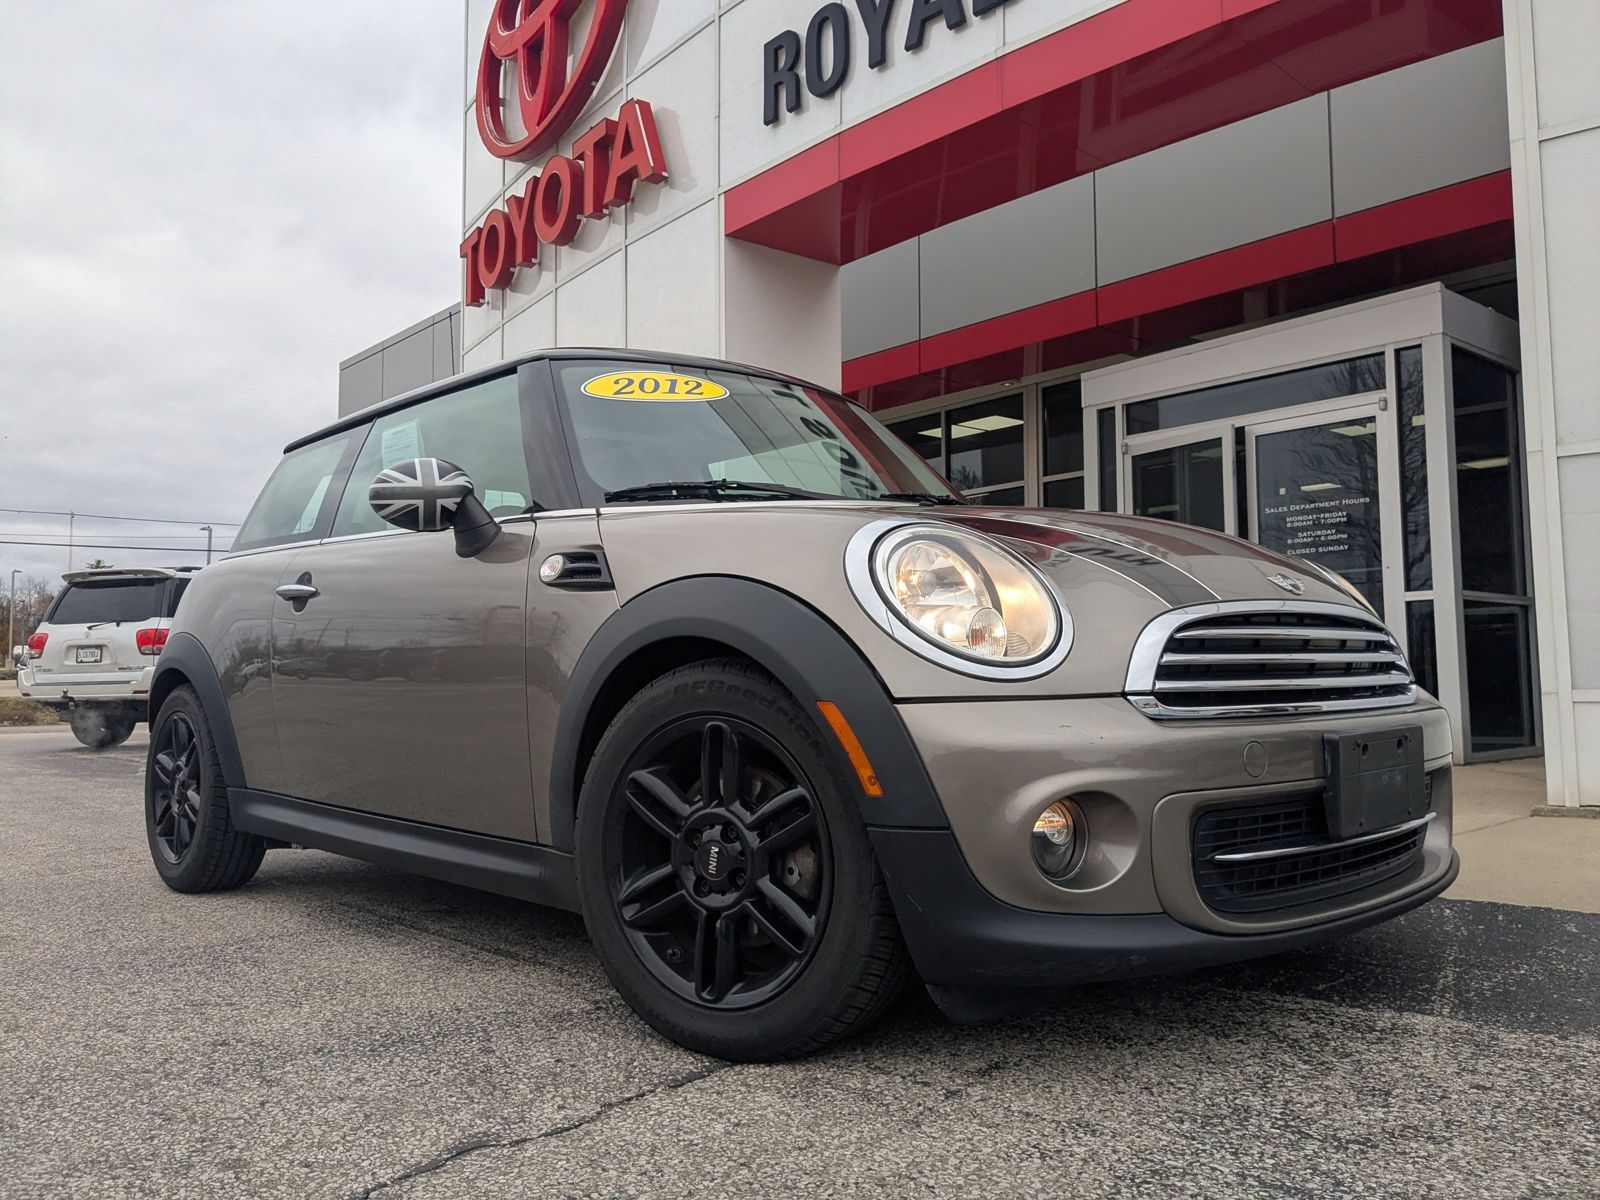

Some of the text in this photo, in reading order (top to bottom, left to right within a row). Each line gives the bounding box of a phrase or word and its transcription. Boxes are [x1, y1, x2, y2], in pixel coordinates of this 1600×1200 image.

[763, 0, 1012, 126] ROYA
[460, 97, 669, 307] TOYOTA
[613, 377, 704, 396] 2012
[1297, 529, 1336, 538] SATURDAY
[1287, 544, 1349, 555] CLOSED SUNDAY
[707, 846, 719, 875] MINI
